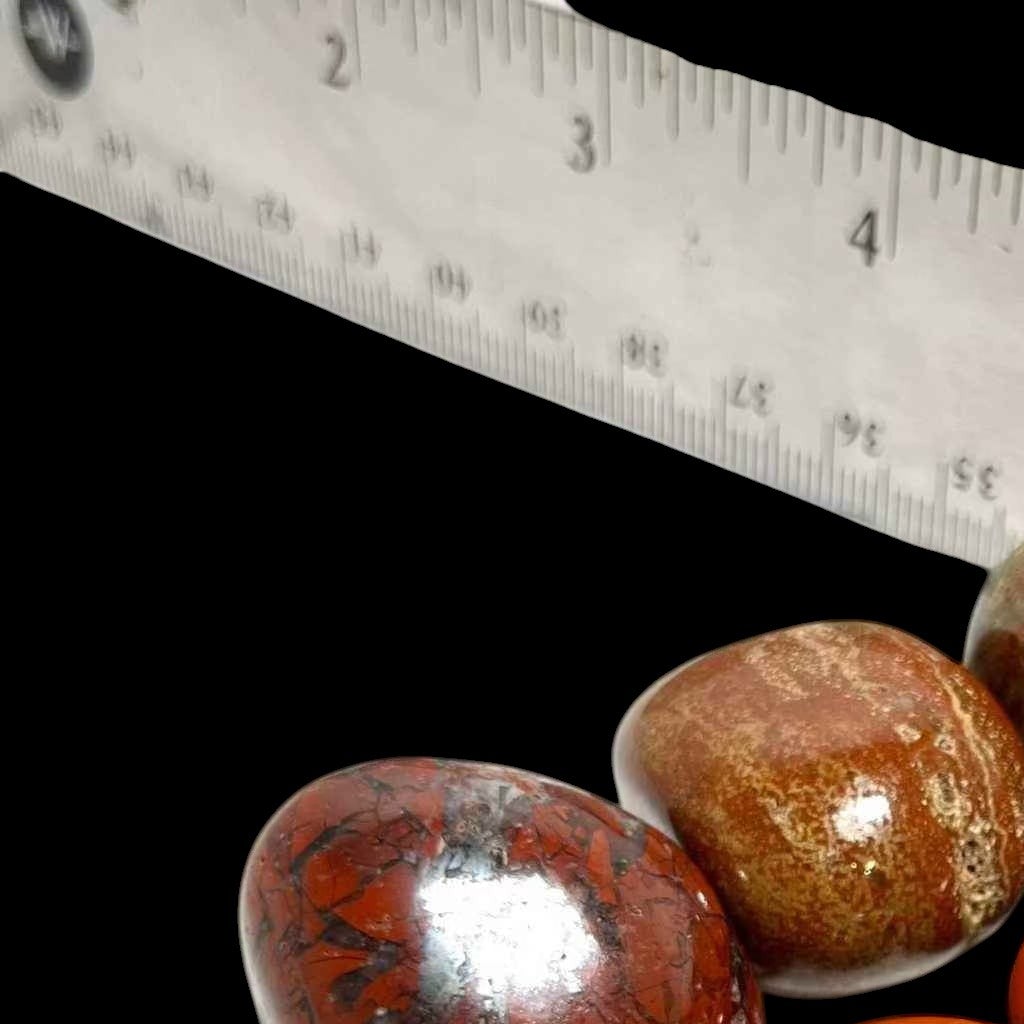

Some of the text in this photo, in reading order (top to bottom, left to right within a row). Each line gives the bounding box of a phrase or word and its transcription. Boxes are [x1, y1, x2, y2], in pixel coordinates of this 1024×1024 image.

[321, 28, 352, 90] 2
[564, 110, 598, 174] 3
[848, 208, 878, 268] 4
[731, 372, 773, 418] 37
[837, 412, 885, 458] 36
[950, 456, 999, 502] 35
